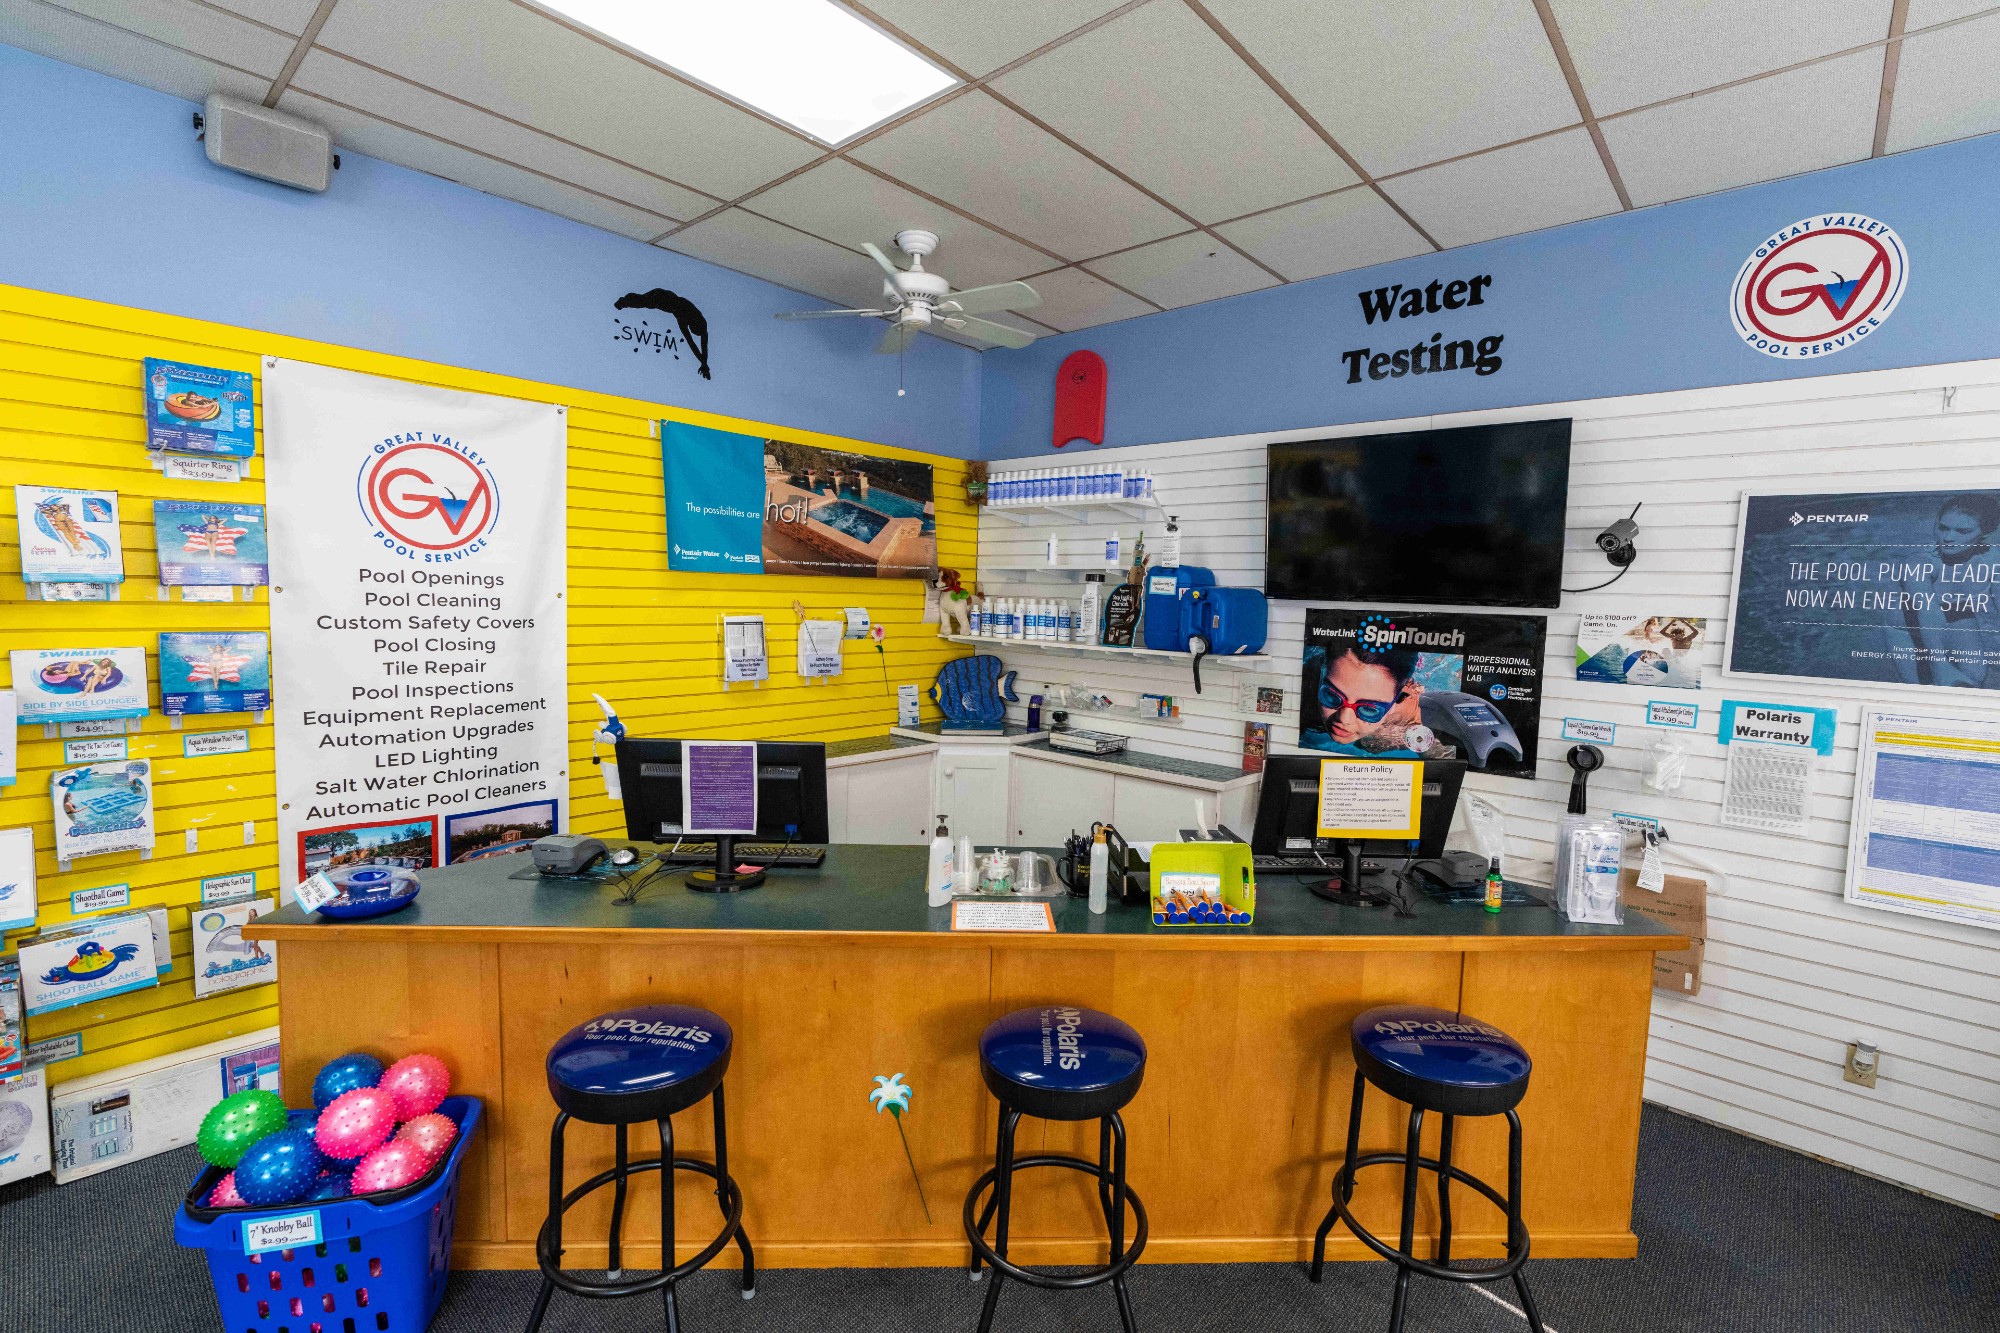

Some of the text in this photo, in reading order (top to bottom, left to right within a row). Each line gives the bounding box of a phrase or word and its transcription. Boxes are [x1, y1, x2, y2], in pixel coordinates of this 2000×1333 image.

[1755, 216, 1889, 258] GREAT VALLEY
[1358, 274, 1492, 325] Water
[621, 326, 678, 352] SWIM
[1746, 317, 1880, 356] POOL SERVICE
[1341, 332, 1504, 384] Testing
[374, 431, 486, 466] GREAT VALLEY
[173, 459, 233, 472] Squirter Ring
[686, 502, 760, 519] The possibilities are
[765, 489, 808, 525] hot!
[1806, 514, 1869, 523] PENTAIR
[373, 530, 487, 563] POOL SERVICE
[359, 568, 505, 588] Pool Openings
[1789, 562, 1820, 581] THE
[1826, 562, 1871, 582] POOL
[1878, 562, 1934, 582] PUMP
[365, 592, 501, 611] Pool Cleaning
[1785, 589, 1989, 613] NOW AN ENERGY STAR
[316, 615, 535, 633] Custom Safety Covers
[1312, 627, 1356, 638] WaterLink
[1363, 625, 1465, 647] SpinTouch
[39, 649, 118, 658] SWIMLINE
[374, 637, 496, 654] Pool Closing
[1893, 645, 1928, 653] Increase
[1951, 648, 1981, 656] annual
[1468, 655, 1531, 666] PROFESSIONAL
[1851, 650, 1884, 659] ENERGY
[1886, 652, 1908, 660] STAR
[1910, 654, 1946, 662] Certified
[383, 659, 487, 677] Tile Repair
[1467, 665, 1537, 676] WATER ANALYSIS
[1466, 674, 1482, 682] LAB
[352, 681, 514, 700] Pool Inspections
[23, 702, 47, 710] SIDE
[91, 697, 138, 706] LOUNGER
[303, 698, 546, 727] Equipment Replacement
[1746, 709, 1802, 724] Polaris
[319, 719, 534, 748] Automation Upgrades
[1735, 725, 1810, 745] Warranty
[375, 745, 498, 768] LED Lighting
[315, 761, 540, 795] Salt Water Chlorination
[1343, 765, 1393, 774] Return Policy
[306, 779, 547, 821] Automatic Pool Cleaners
[205, 877, 252, 891] Holographic Sun Chair
[75, 889, 125, 904] Shootball Game
[35, 970, 141, 1002] SHOOTBALL GAME
[608, 1019, 712, 1043] Polaris
[1399, 1020, 1503, 1038] Polaris
[62, 1039, 77, 1047] Chair
[647, 1037, 697, 1052] reputation.
[1055, 1015, 1086, 1070] Polaris
[260, 1220, 295, 1234] Knobby
[295, 1216, 313, 1229] Ball
[260, 1236, 289, 1245] $2.99
